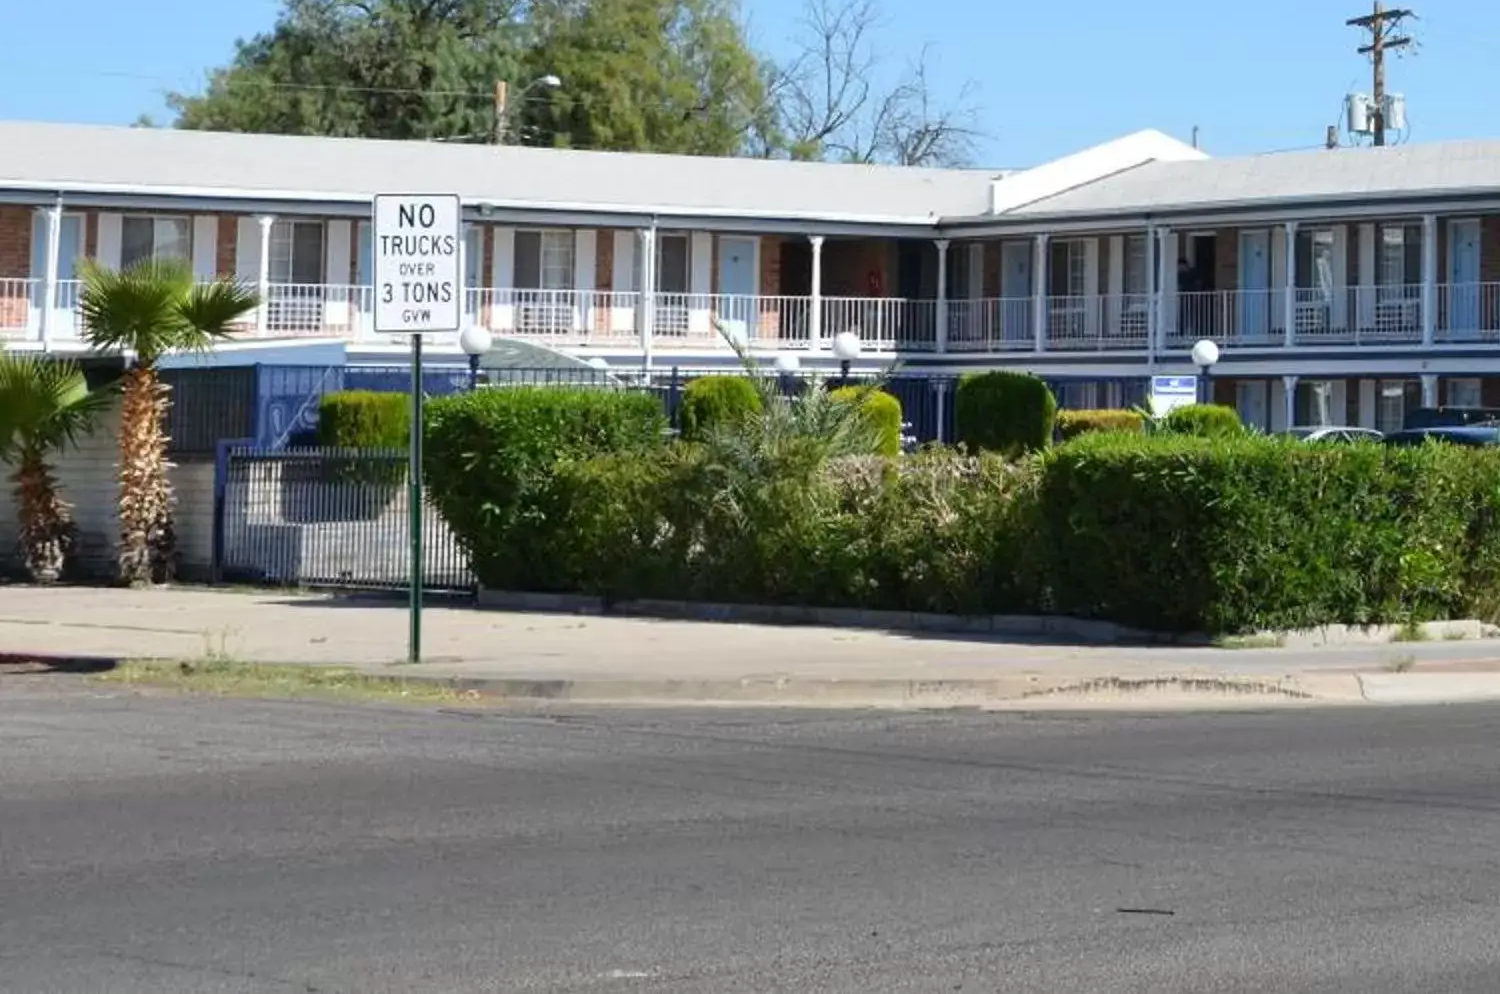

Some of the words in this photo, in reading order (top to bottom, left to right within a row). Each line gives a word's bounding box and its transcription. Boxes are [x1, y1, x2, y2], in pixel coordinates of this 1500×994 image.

[399, 203, 435, 229] NO
[380, 235, 454, 257] TRUCKS
[399, 263, 435, 276] OVER
[382, 282, 393, 303] 3
[402, 281, 452, 303] TONS
[402, 310, 431, 323] GVW
